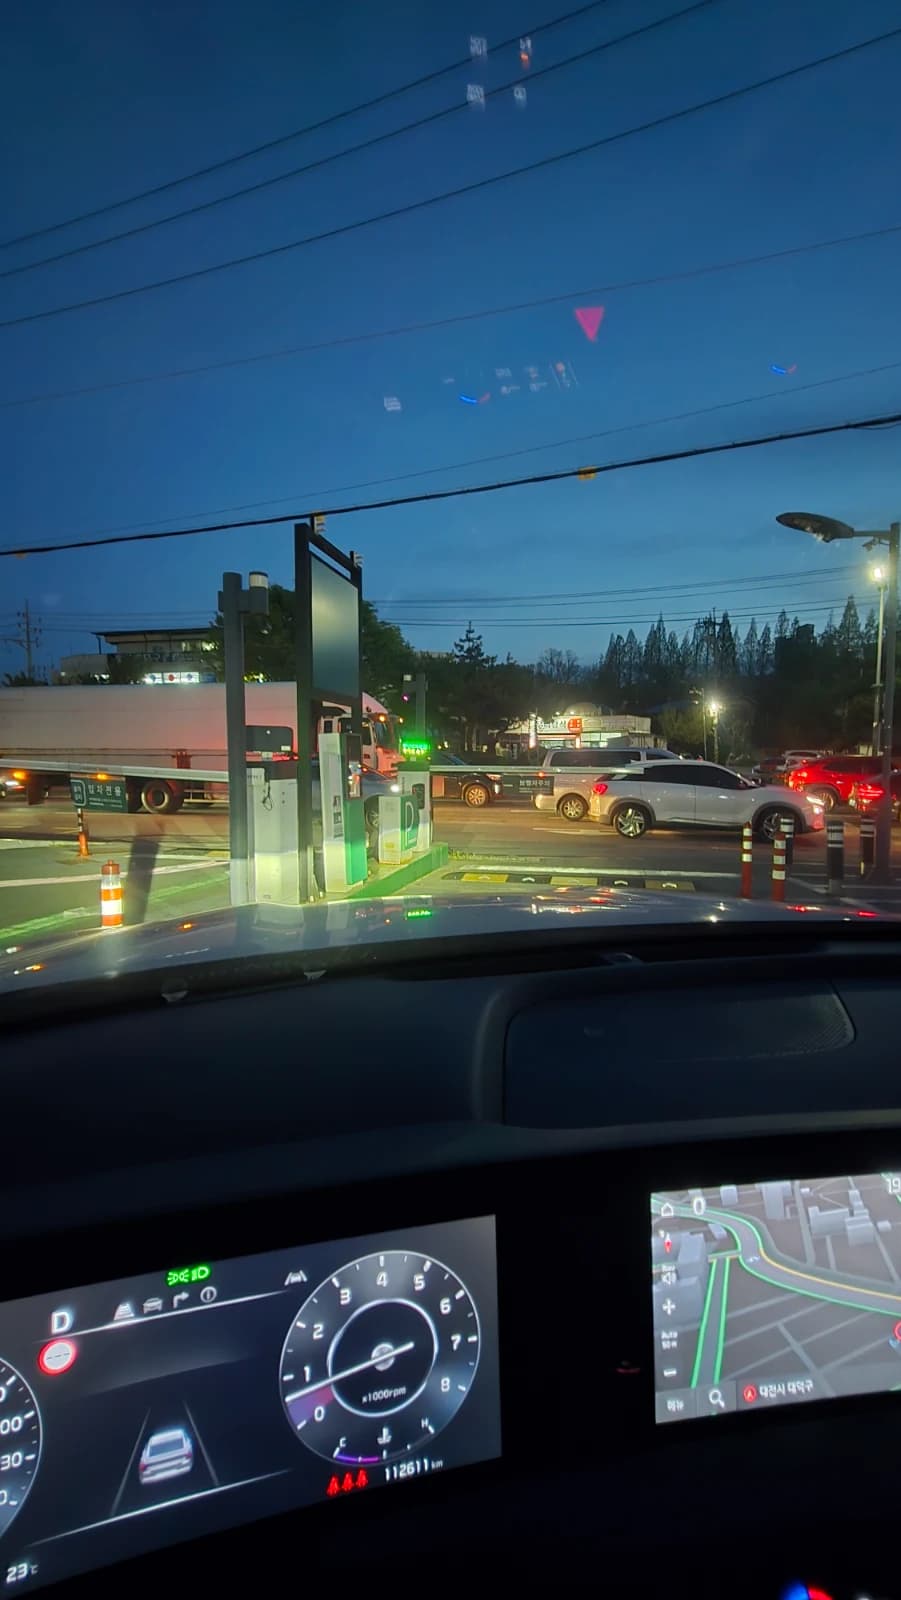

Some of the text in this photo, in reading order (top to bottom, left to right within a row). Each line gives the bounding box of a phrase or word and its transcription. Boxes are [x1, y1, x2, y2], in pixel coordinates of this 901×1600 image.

[376, 1271, 389, 1288] 4
[413, 1273, 426, 1292] 5
[340, 1288, 352, 1306] 3
[439, 1297, 452, 1315] 6
[51, 1310, 74, 1335] D
[312, 1321, 325, 1341] 2
[450, 1333, 462, 1351] 7
[303, 1364, 312, 1383] 1
[440, 1376, 451, 1393] 8
[759, 1383, 785, 1399] 대전시
[314, 1405, 326, 1422] 0
[421, 1416, 430, 1429] H
[339, 1435, 347, 1448] C
